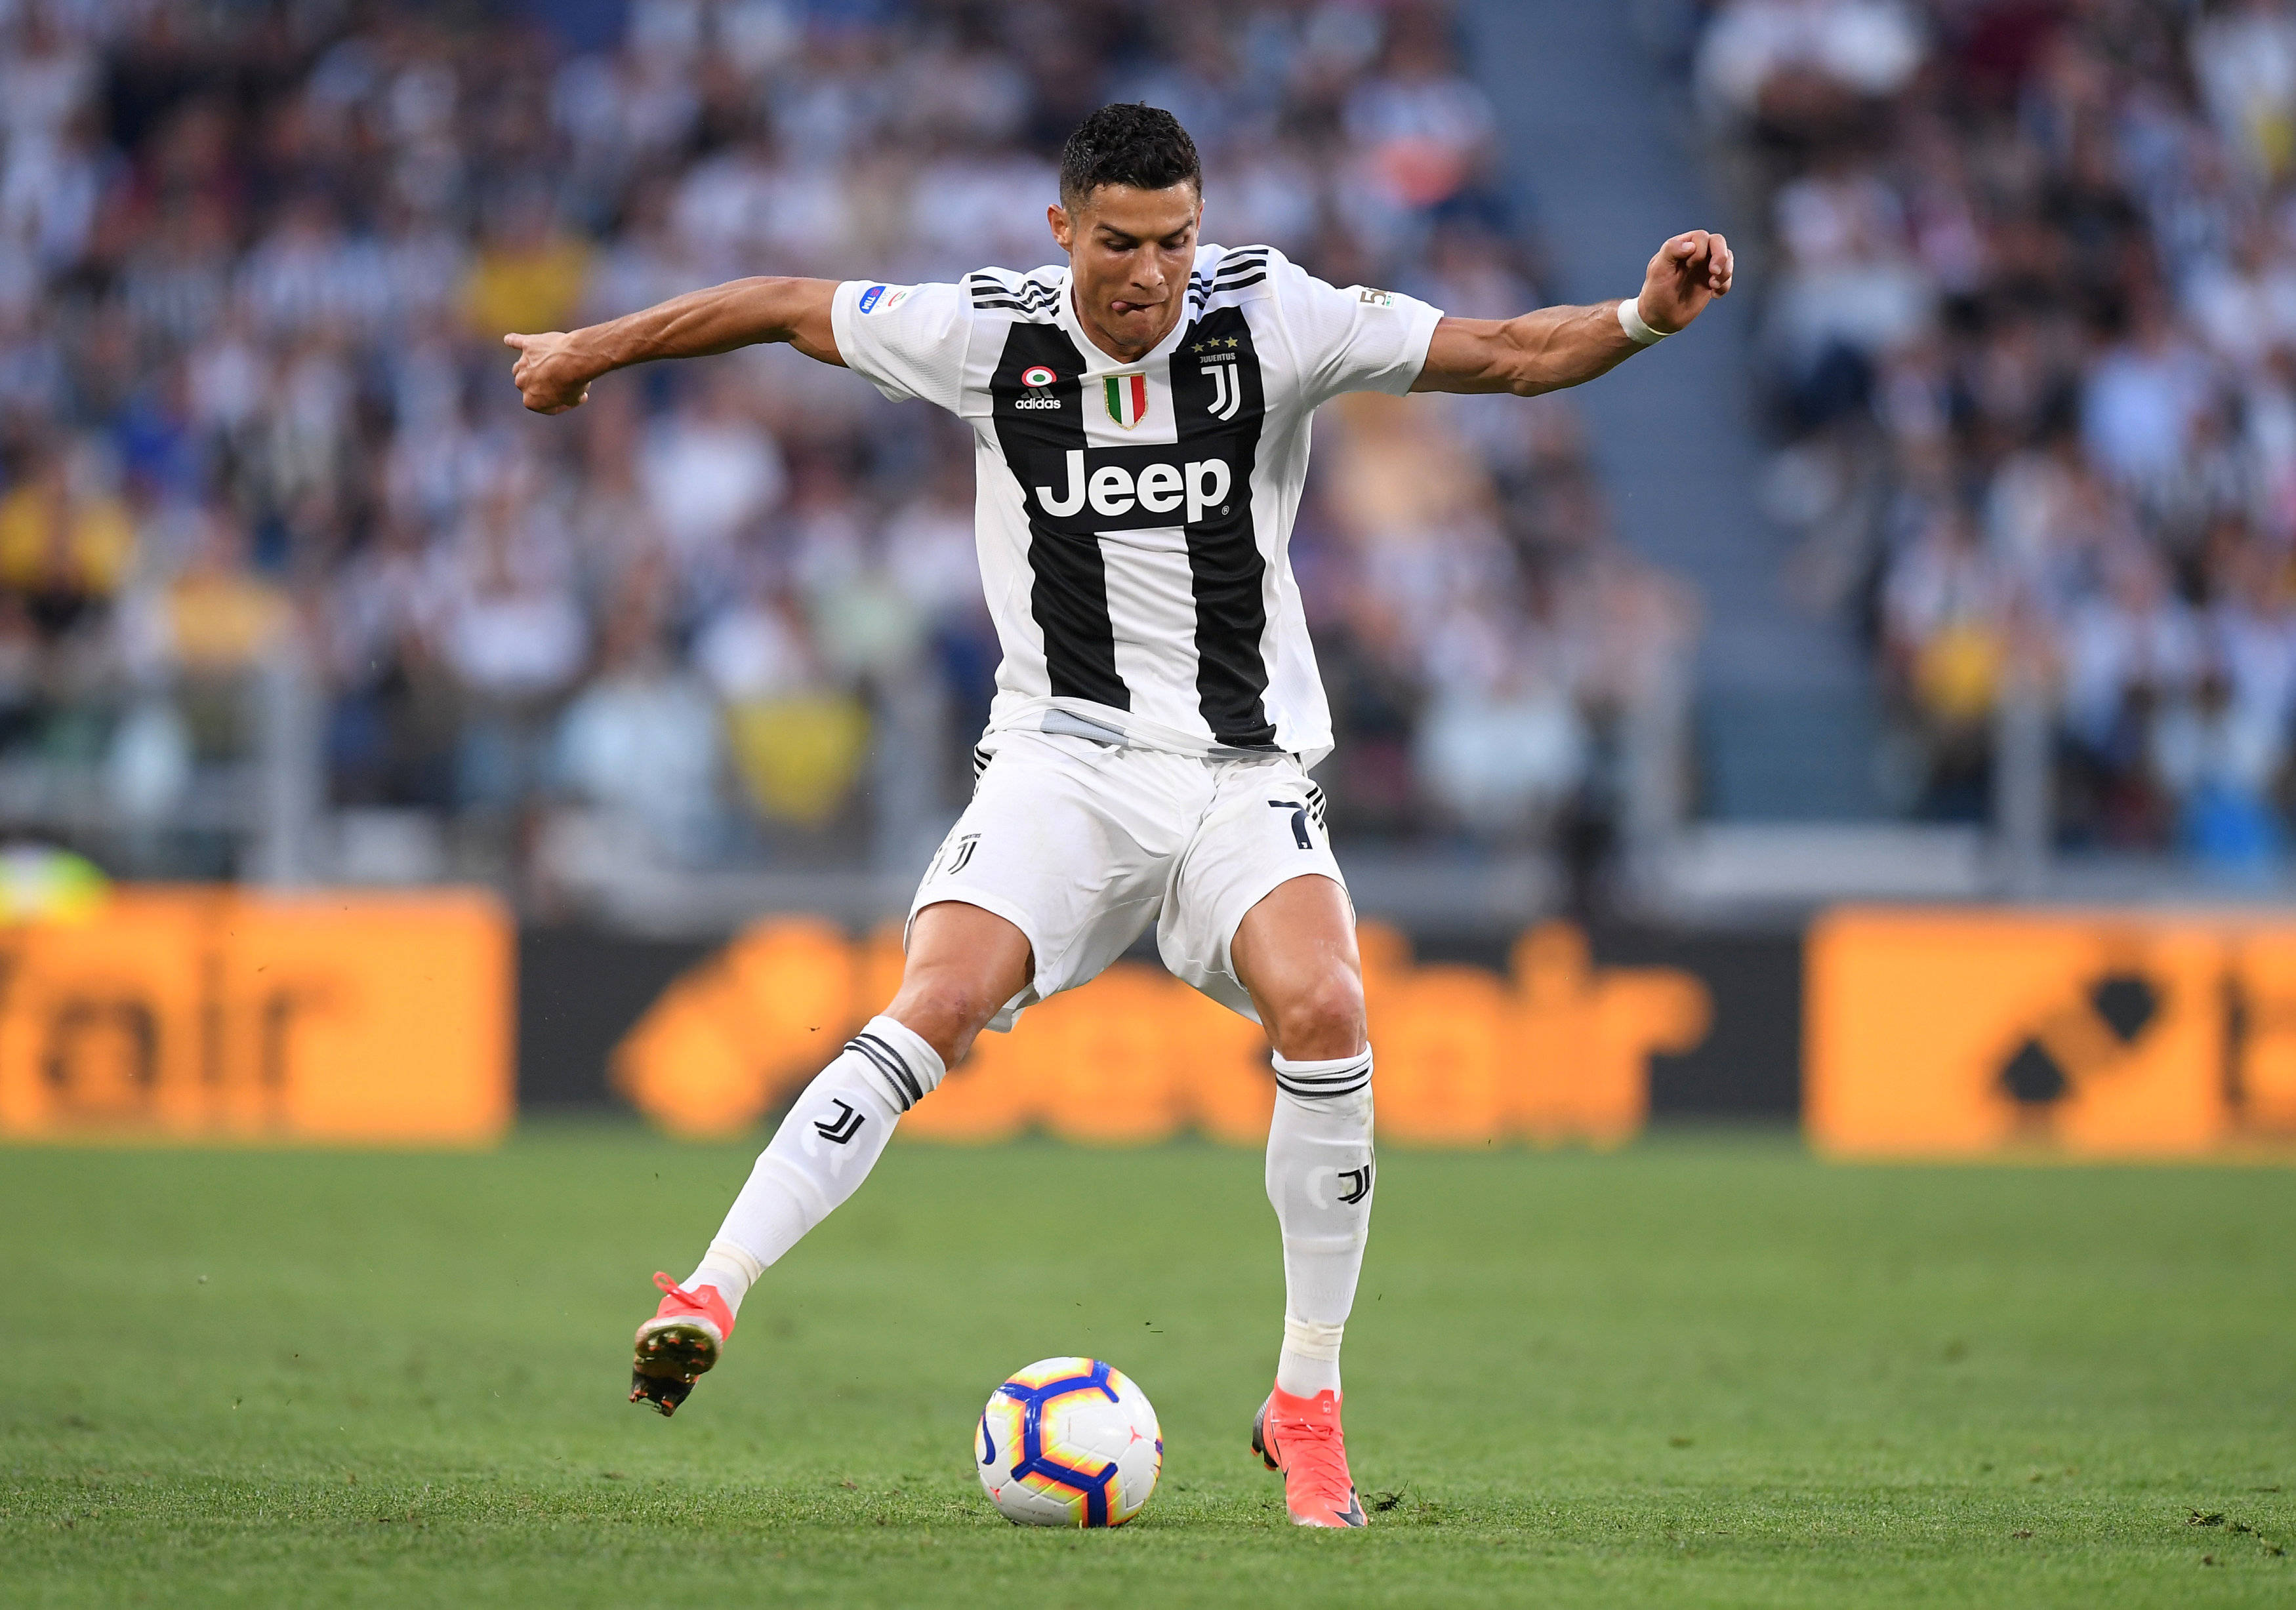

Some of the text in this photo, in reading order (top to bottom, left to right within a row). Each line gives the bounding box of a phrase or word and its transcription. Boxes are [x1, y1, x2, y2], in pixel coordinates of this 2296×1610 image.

[861, 296, 876, 310] TIM
[1199, 352, 1237, 363] JUVENTUS
[1015, 397, 1061, 409] adidas
[1035, 449, 1231, 523] Jeep
[1267, 800, 1313, 850] 7
